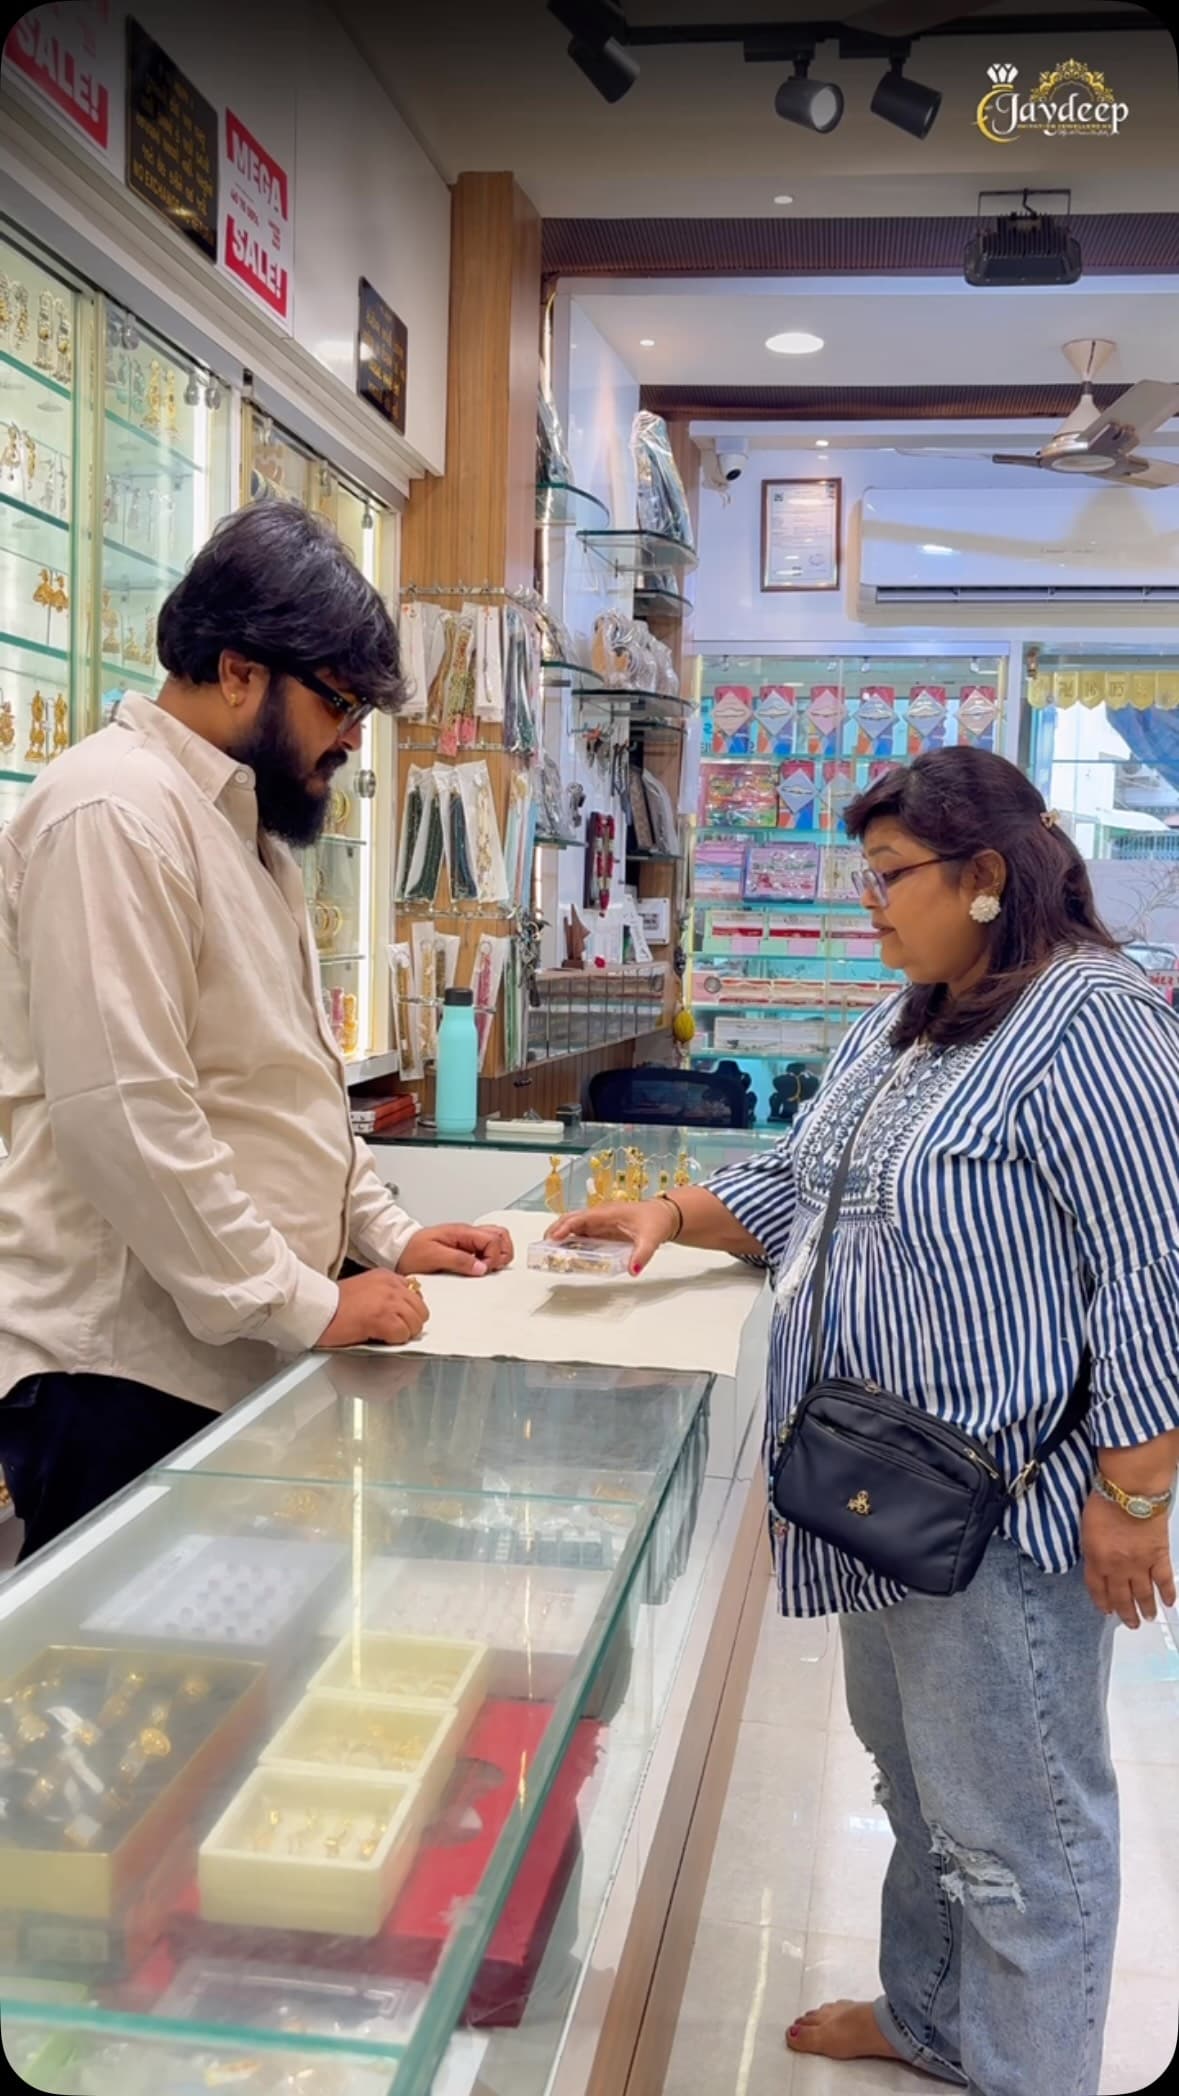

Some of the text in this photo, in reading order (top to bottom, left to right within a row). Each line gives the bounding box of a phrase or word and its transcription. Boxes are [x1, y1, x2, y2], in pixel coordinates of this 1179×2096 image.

[16, 15, 100, 123] SALE!
[232, 130, 283, 217] MEGA
[232, 226, 281, 299] SALE!
